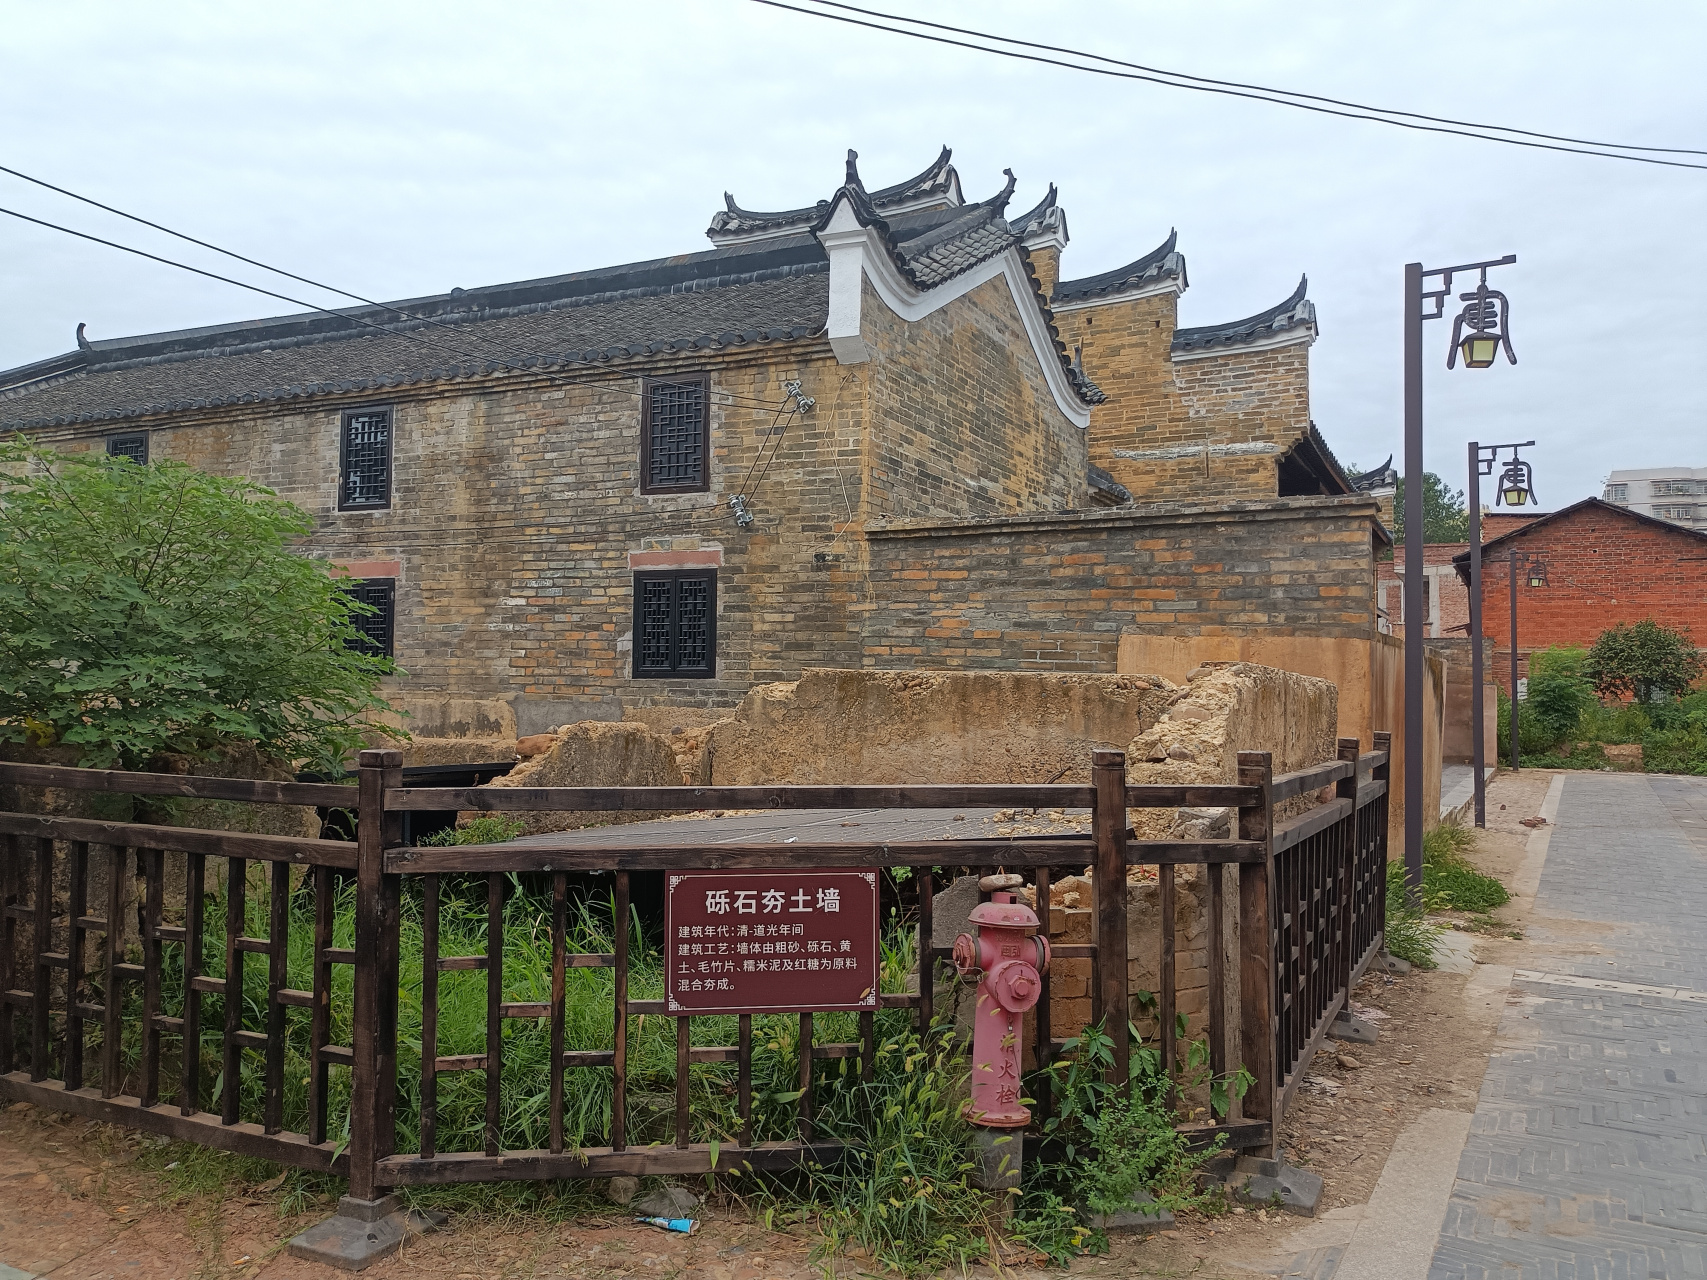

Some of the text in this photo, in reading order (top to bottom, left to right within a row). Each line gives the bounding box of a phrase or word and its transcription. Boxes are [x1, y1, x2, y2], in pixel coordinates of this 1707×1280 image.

[706, 888, 841, 915] 砾石夯土墙
[678, 940, 852, 956] 建筑工艺：墙体由粗砂、砾石、黄
[678, 957, 858, 974] 土、毛竹片、糯米泥及红糖为原料
[677, 978, 735, 992] 混合夯成。
